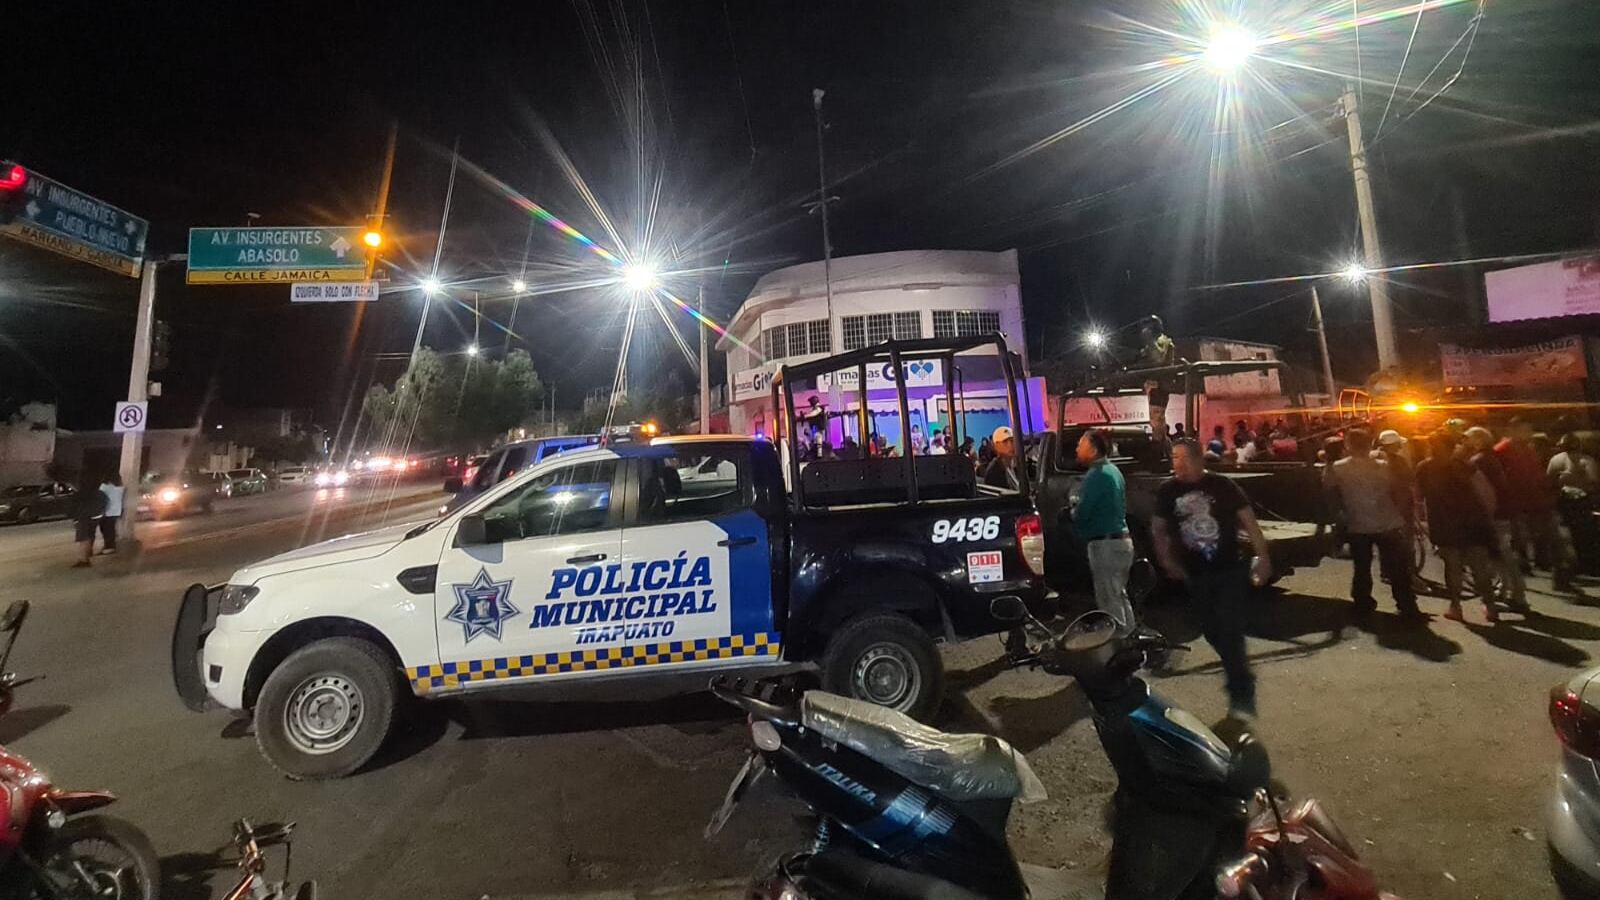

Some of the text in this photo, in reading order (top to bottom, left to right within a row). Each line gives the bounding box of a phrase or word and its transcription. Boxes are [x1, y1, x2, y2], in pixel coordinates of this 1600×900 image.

[48, 184, 118, 229] INSURGENTES
[20, 225, 74, 252] MARIANO
[55, 210, 129, 252] PUEBLO NUEVO
[236, 230, 323, 245] INSURGENTES
[238, 248, 299, 263] ABASOLO
[224, 270, 331, 281] CALLE JAMAICA
[325, 285, 338, 298] SOLO
[341, 285, 353, 298] CON
[931, 515, 1001, 544] 9436
[970, 553, 1000, 567] 911
[545, 550, 713, 600] POLICÍA
[529, 589, 717, 629] MUNICIPAL
[575, 620, 675, 645] IRAPUATO
[815, 762, 877, 803] ITALIKA
